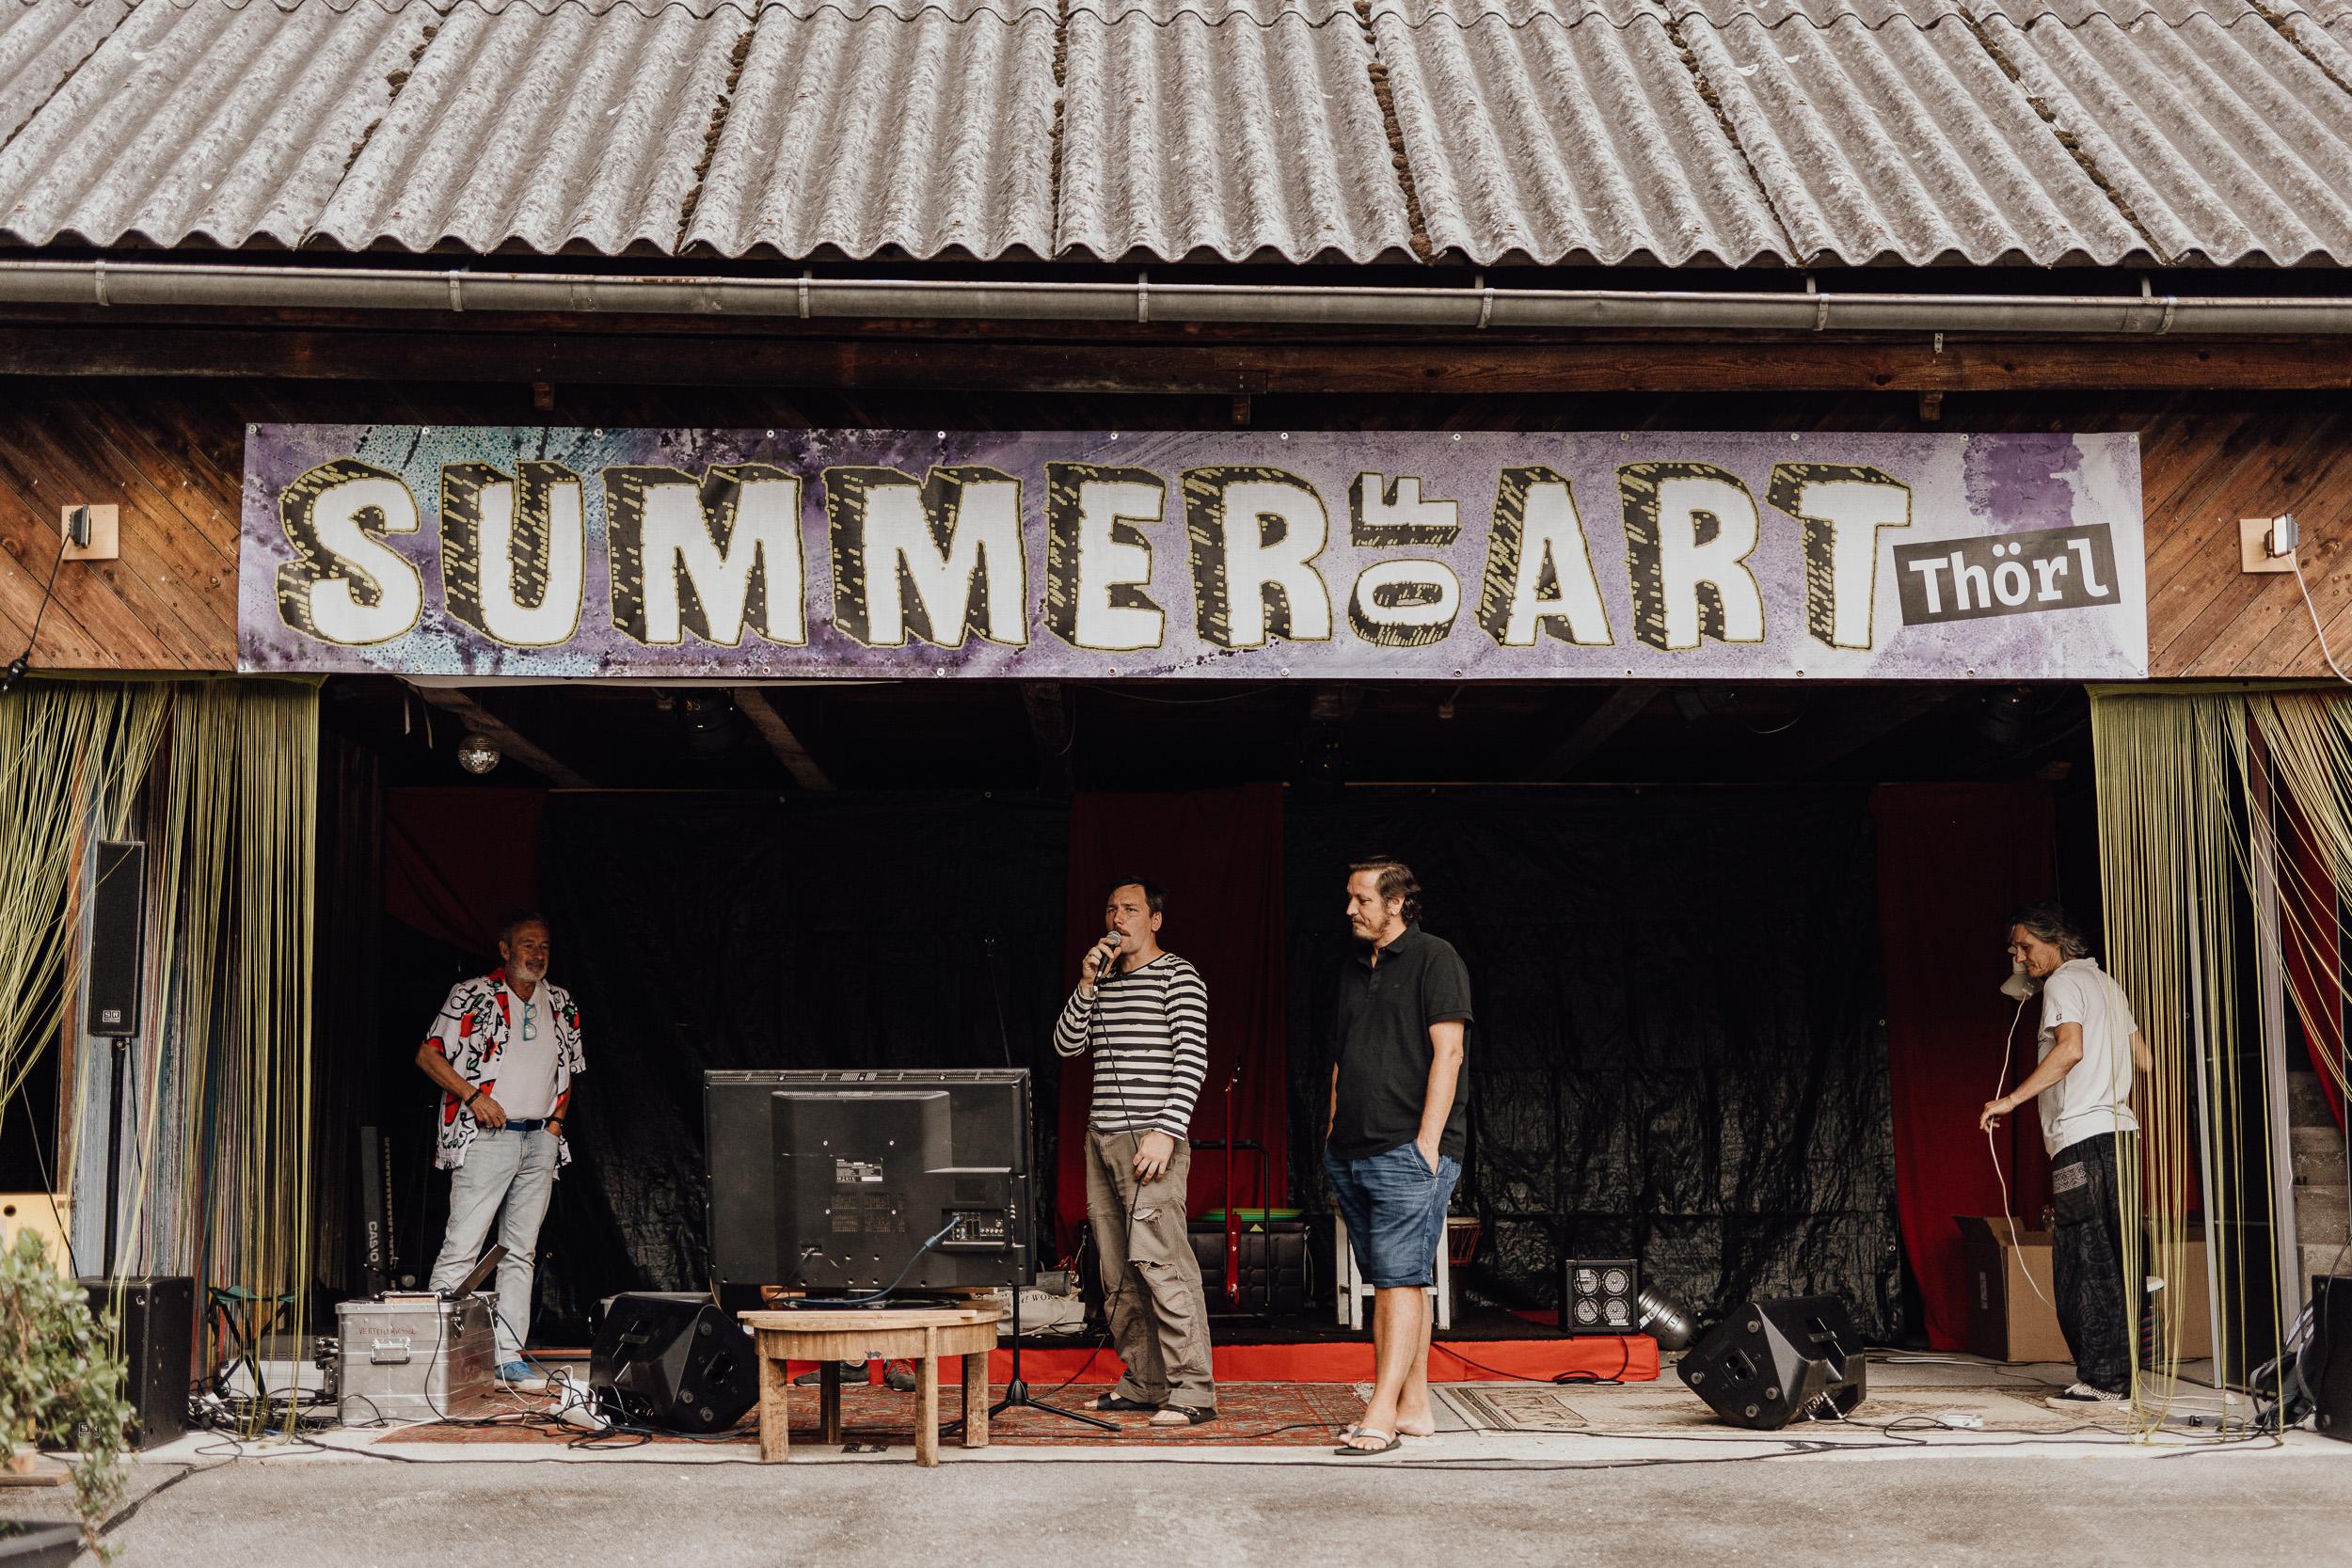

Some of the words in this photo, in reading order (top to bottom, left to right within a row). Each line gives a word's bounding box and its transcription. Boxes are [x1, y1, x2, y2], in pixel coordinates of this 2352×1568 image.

[276, 457, 1331, 651] SUMMER
[1348, 472, 1461, 647] OF
[1474, 462, 1913, 652] ART
[1908, 537, 2111, 615] Thörl
[369, 1221, 379, 1262] CASIO
